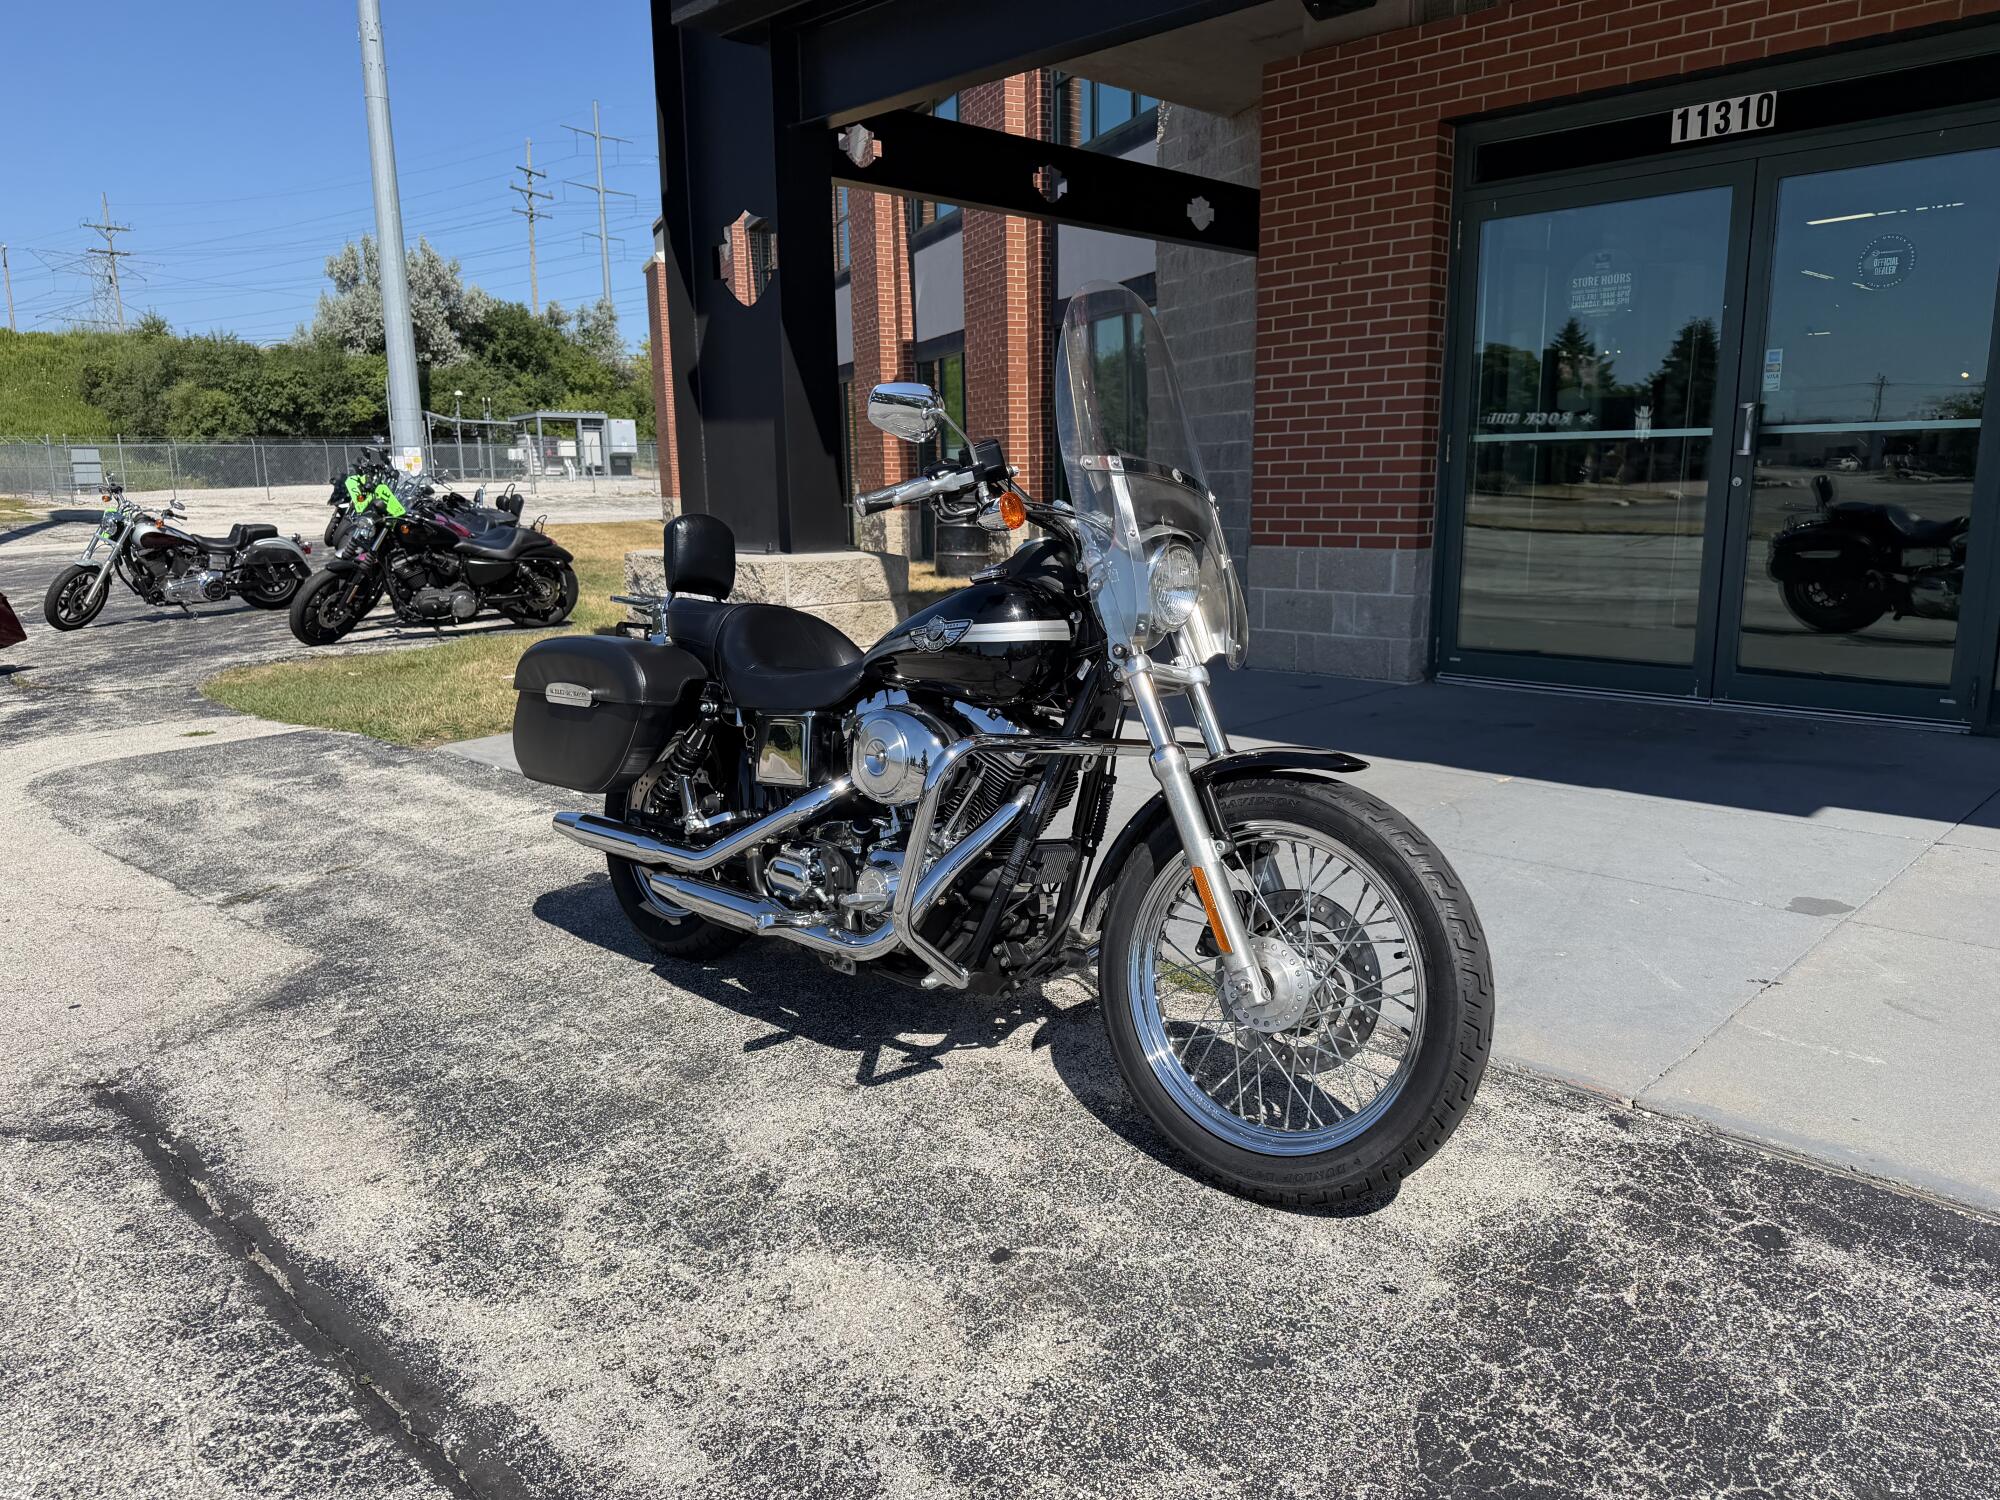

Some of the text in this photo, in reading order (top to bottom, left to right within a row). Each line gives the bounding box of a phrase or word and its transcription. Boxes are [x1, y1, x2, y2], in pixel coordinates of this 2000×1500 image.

[1678, 93, 1773, 140] 11310
[1873, 257, 1899, 267] OFFICIAL
[1874, 266, 1897, 275] DEALER
[1572, 272, 1632, 288] STORE HOURS
